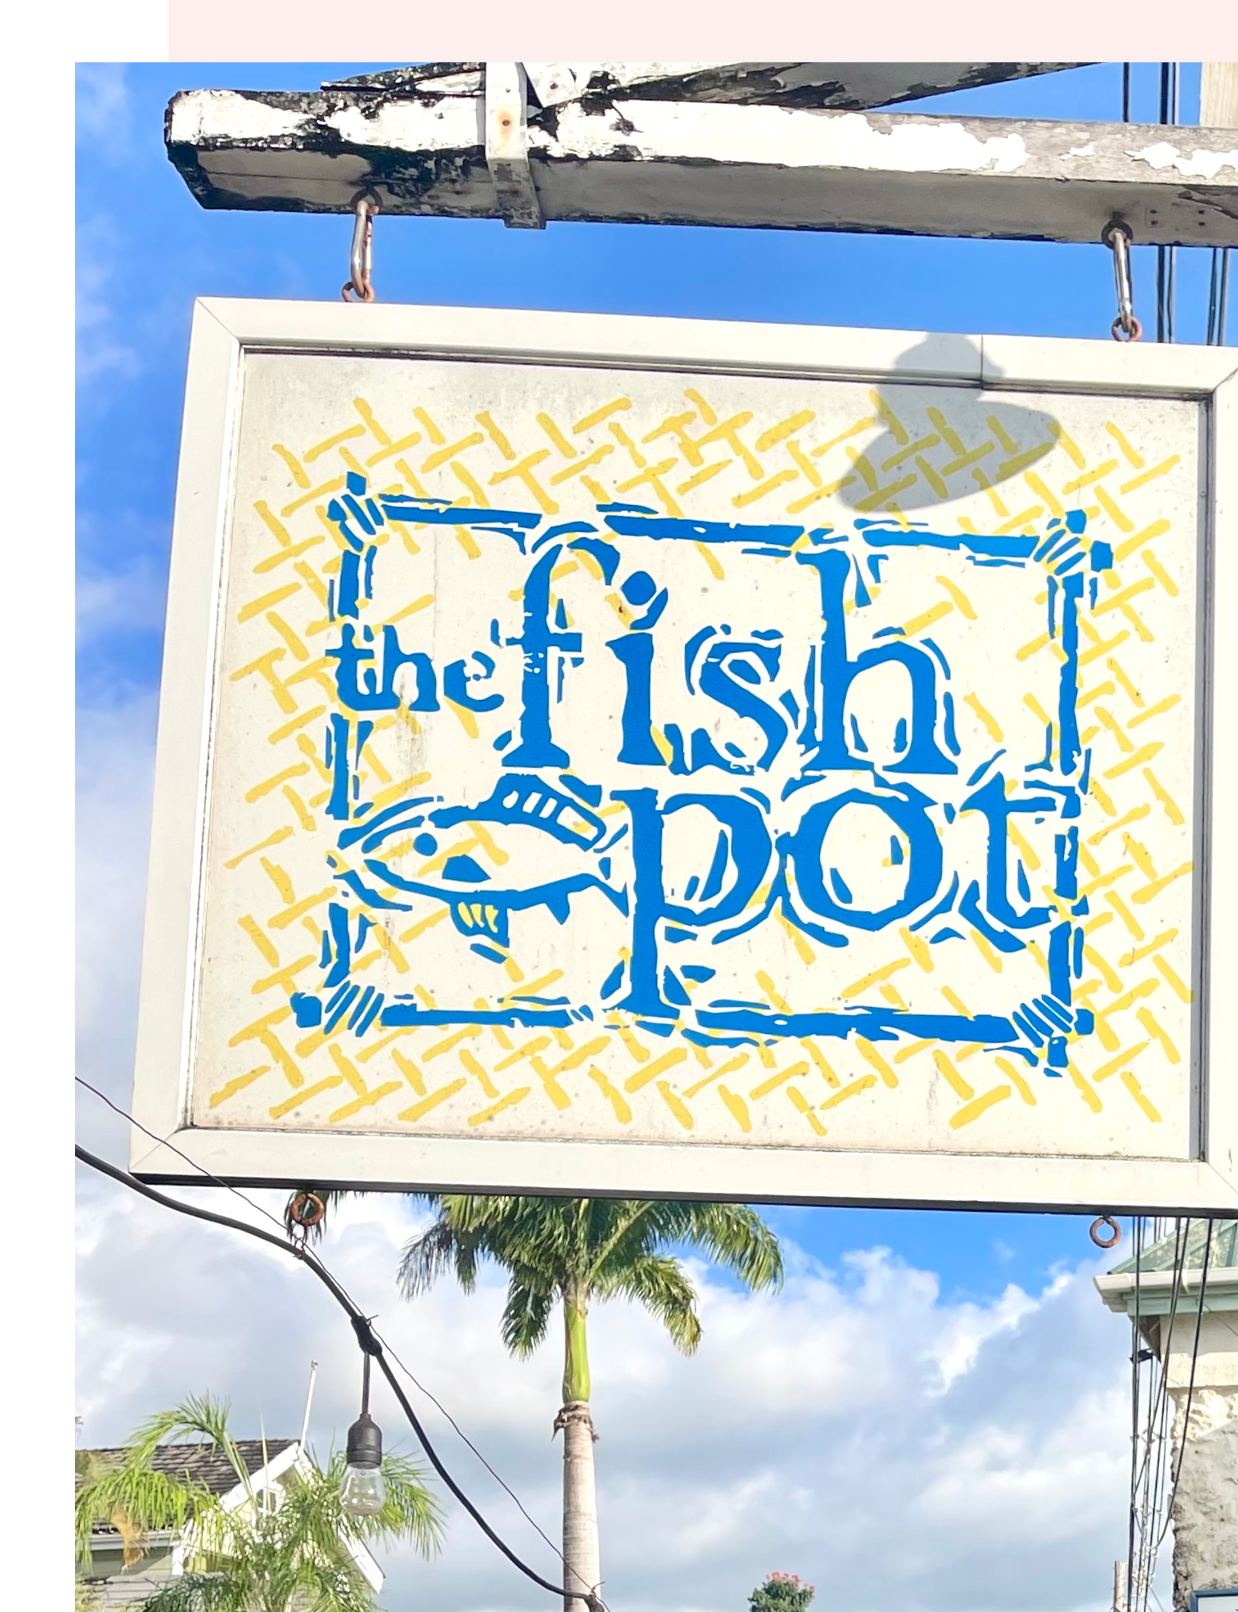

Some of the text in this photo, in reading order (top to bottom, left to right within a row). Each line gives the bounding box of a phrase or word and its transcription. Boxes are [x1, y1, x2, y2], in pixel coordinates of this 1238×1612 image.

[325, 536, 959, 775] the fish
[609, 771, 1060, 1020] pot
